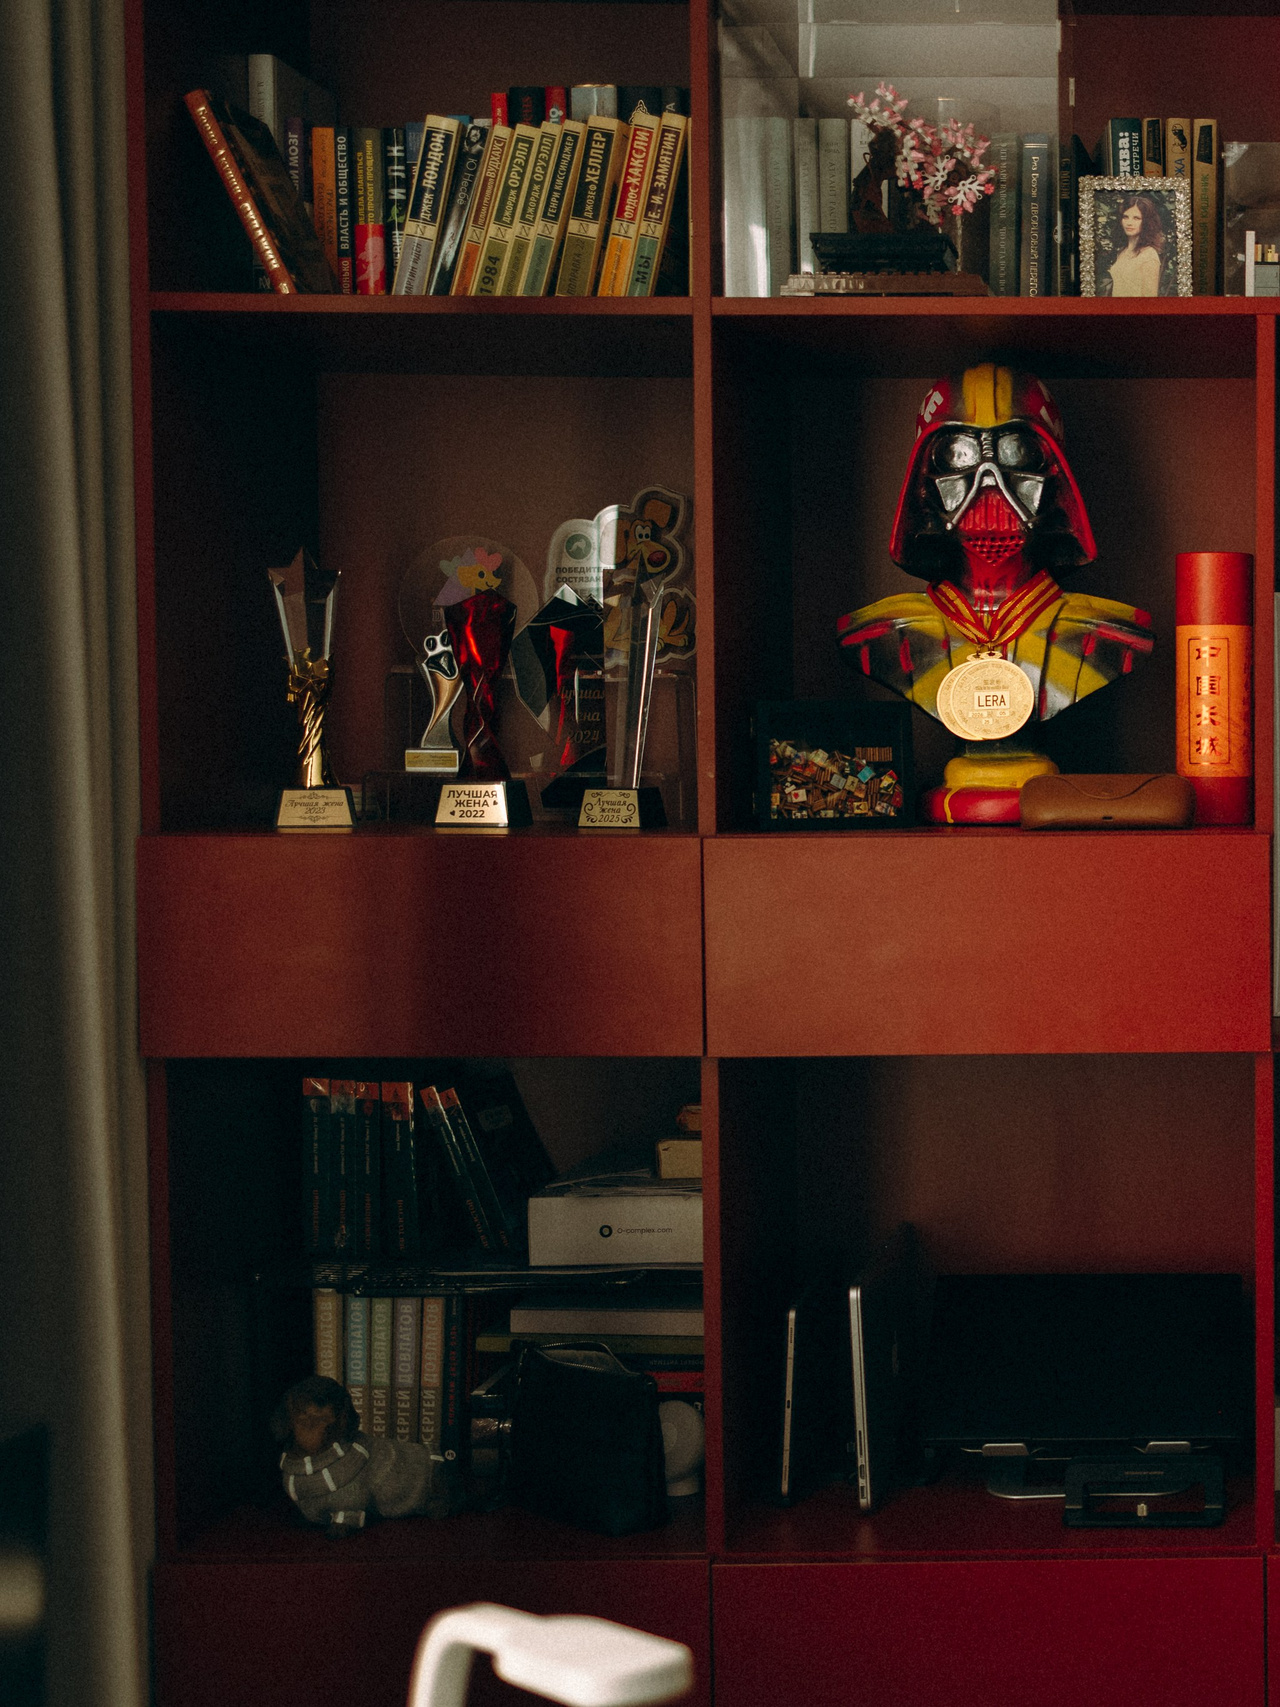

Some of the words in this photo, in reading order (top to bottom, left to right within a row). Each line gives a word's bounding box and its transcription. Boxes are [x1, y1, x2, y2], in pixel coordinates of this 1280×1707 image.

[197, 106, 219, 144] Борис
[216, 150, 242, 194] Акунин
[288, 131, 299, 166] МОЗГ
[337, 135, 347, 194] ОБЩЕСТВО
[366, 140, 374, 180] ПРОЩЕНИЯ
[422, 132, 446, 190] ЛОНДОН
[466, 158, 478, 170] Ю
[487, 140, 504, 177] ВУДХАУС
[509, 142, 529, 187] ОРУЭЛЛ
[587, 133, 606, 183] ХЕЛЛЕР
[629, 130, 650, 185] ХАКСЛИ
[655, 133, 676, 189] ЗАМЯТИН
[1031, 156, 1039, 170] Риз
[457, 172, 474, 204] Несбё
[526, 184, 541, 220] ДЖОРДЖ
[534, 137, 552, 181] ОРУЭЛЛ
[548, 191, 561, 218] ГЕНРИ
[555, 135, 575, 190] КИССИНДЖЕР
[1031, 173, 1039, 198] Боуэн
[1201, 173, 1210, 219] КИШЕЧНИК
[366, 183, 374, 211] ПРОСИТ
[420, 192, 435, 221] ДЖЕК
[503, 189, 517, 223] ДЖОРДЖ
[584, 184, 598, 218] ДЖОЗЕФ
[625, 188, 639, 219] ОЛДОС
[649, 207, 659, 219] Е.
[654, 192, 665, 204] И.
[828, 201, 836, 232] РАСПР
[339, 209, 350, 249] ВЛАСТЬ
[1030, 202, 1039, 259] ДВОРЦОВЫЙ
[342, 260, 350, 294] ЛОНЬКО
[403, 266, 418, 294] МАРТИН
[411, 241, 422, 264] ИДЕН
[480, 255, 500, 295] 1984
[568, 253, 581, 295] ПОПРАВКА
[635, 256, 651, 284] МЫ
[978, 694, 1006, 707] LERA
[285, 800, 319, 808] Лучшая
[447, 790, 497, 798] ЛУЧШАЯ
[459, 810, 485, 818] 2022
[594, 798, 627, 807] Лучшая
[351, 1301, 364, 1381] ДОВЛАТОВ
[374, 1303, 388, 1382] ДОВЛАТОВ
[400, 1304, 413, 1383] ДОВЛАТОВ
[425, 1303, 439, 1383] ДОВЛАТОВ
[396, 1390, 410, 1442] СЕРГЕЙ
[421, 1389, 435, 1442] СЕРГЕЙ
